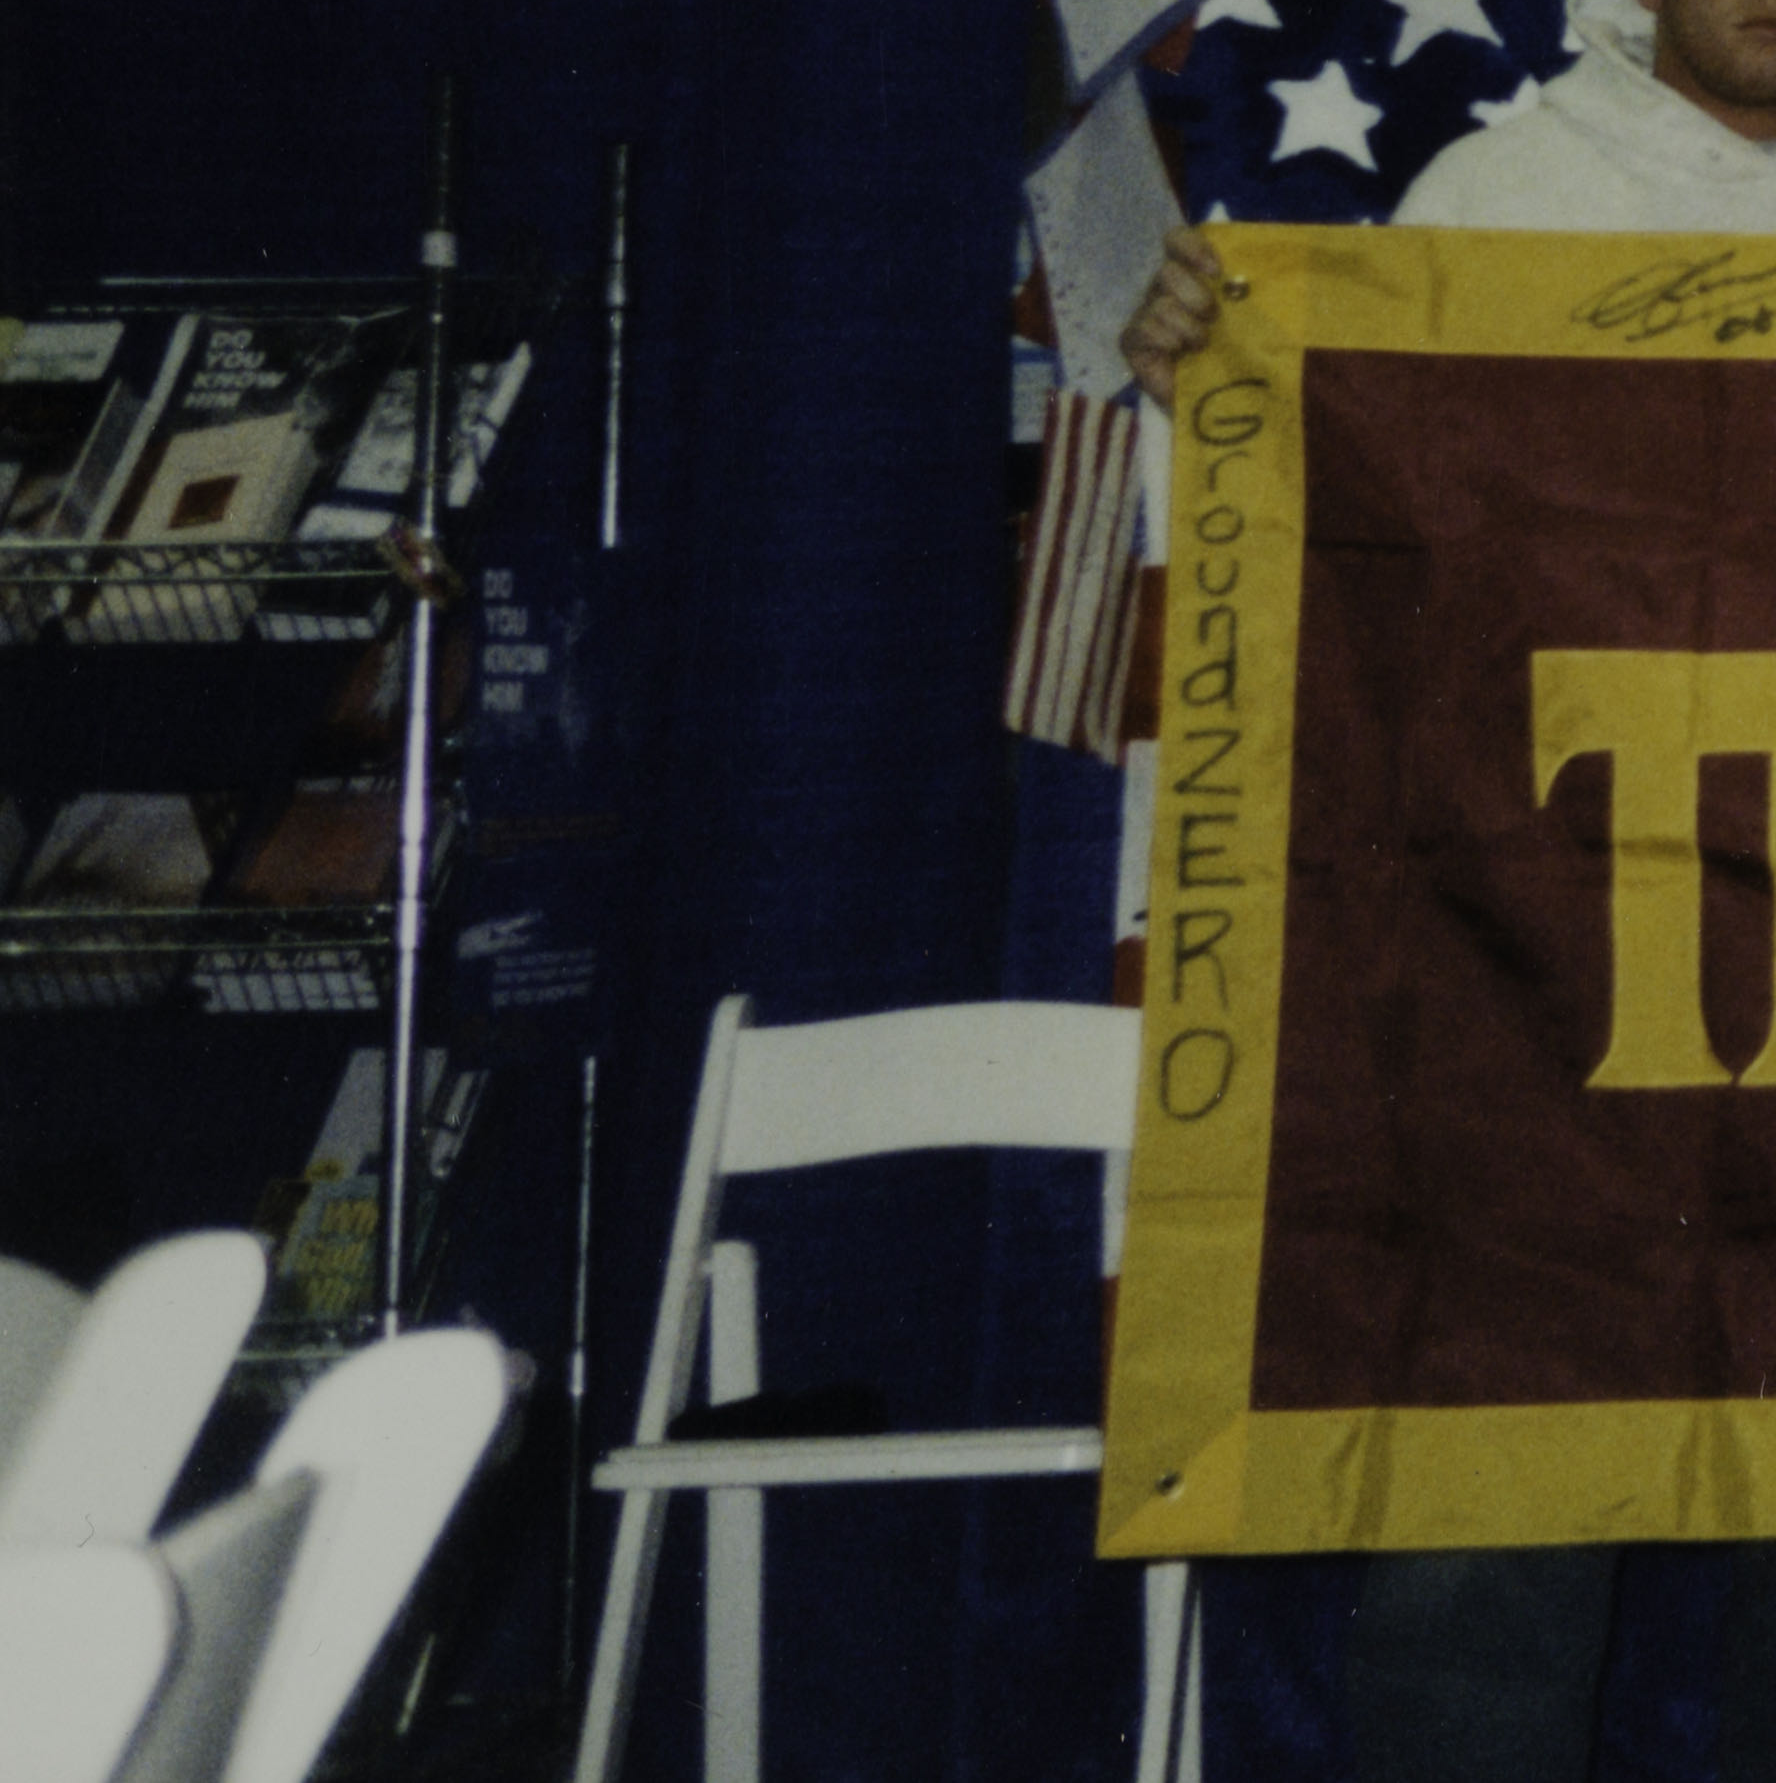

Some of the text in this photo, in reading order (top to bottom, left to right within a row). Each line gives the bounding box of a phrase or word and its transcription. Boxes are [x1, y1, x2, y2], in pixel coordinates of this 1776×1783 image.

[209, 329, 254, 350] DO
[206, 350, 267, 370] YOU
[192, 370, 289, 389] KNOW
[1158, 731, 1245, 1123] ZERO
